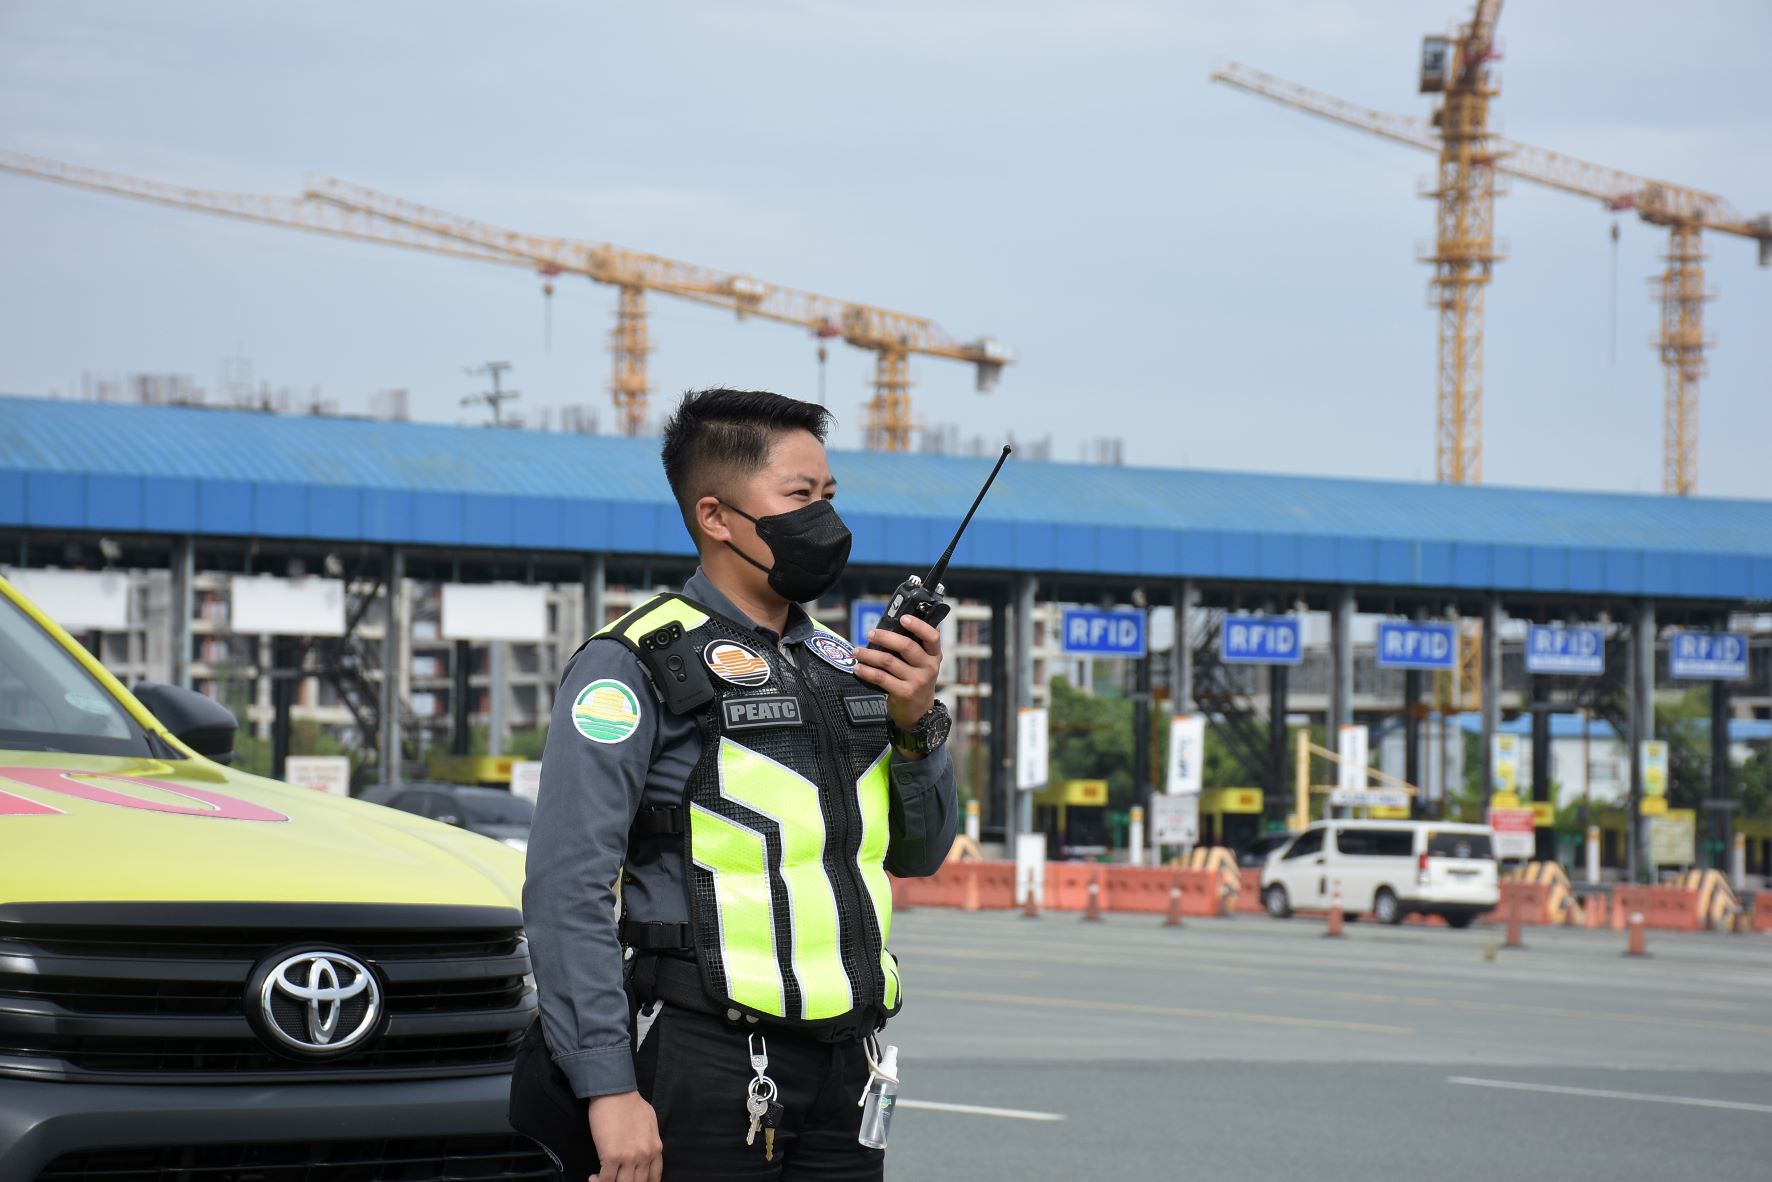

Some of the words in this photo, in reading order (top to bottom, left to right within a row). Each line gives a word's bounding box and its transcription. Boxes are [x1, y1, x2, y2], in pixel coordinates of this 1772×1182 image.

[1068, 616, 1138, 647] RFID
[1229, 623, 1295, 654] RFID
[1384, 629, 1449, 660] RFID
[1535, 629, 1597, 656] RFID
[1680, 634, 1741, 661] RFID
[730, 701, 796, 722] PEATC
